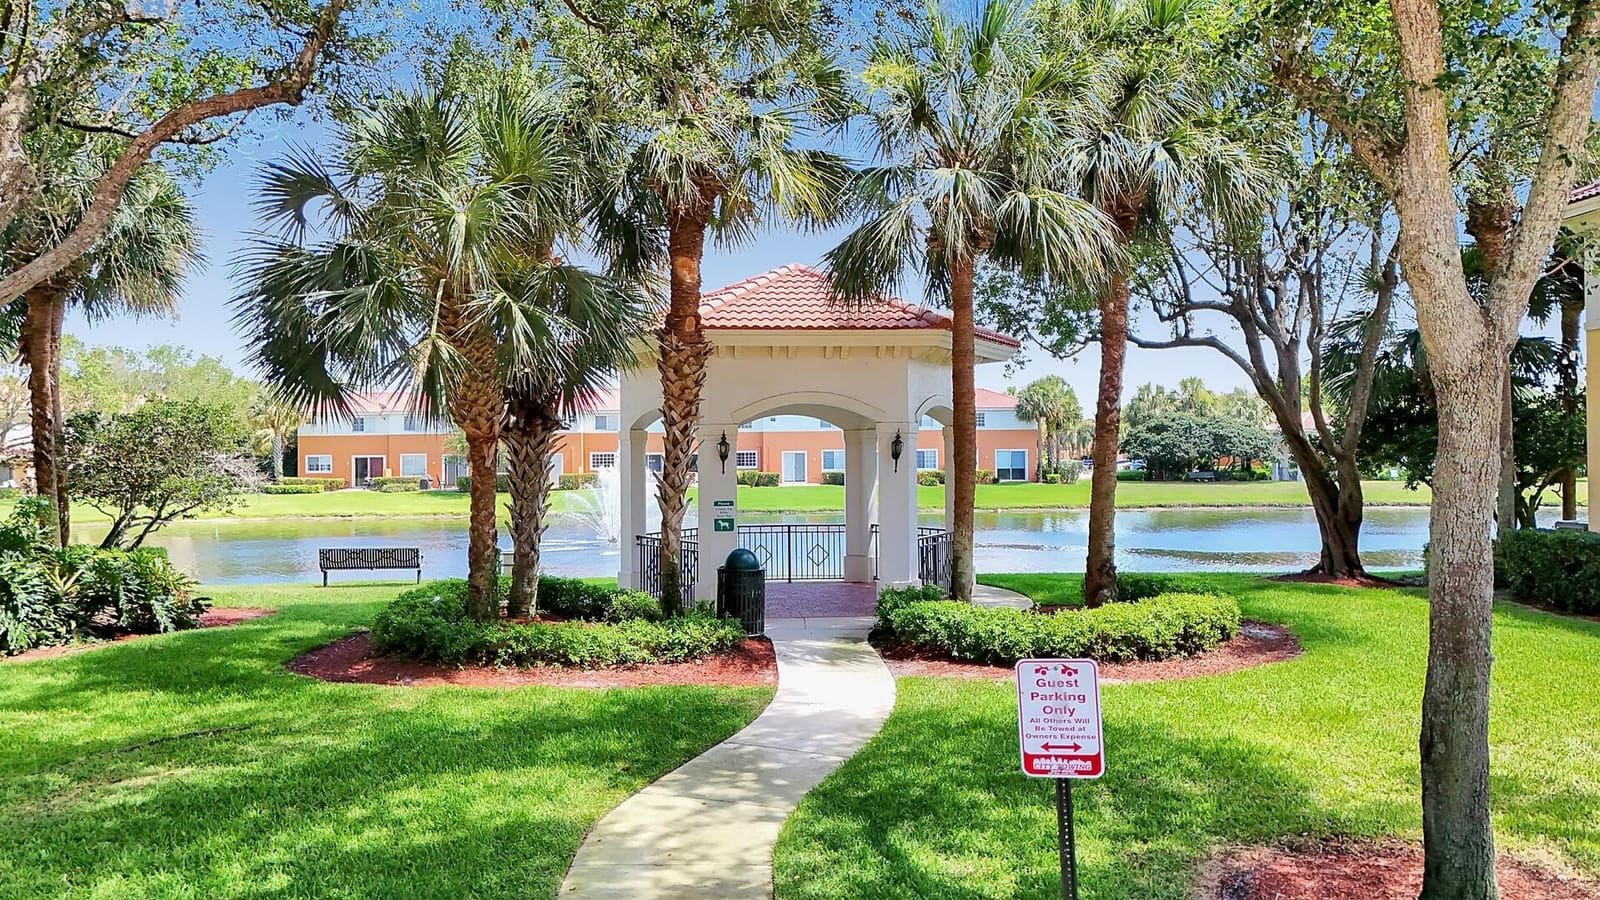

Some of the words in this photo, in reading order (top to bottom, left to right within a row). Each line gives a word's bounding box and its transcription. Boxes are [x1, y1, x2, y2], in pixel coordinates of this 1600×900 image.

[1036, 679, 1079, 688] Guest
[1030, 692, 1086, 703] Parking
[1042, 705, 1075, 717] Only
